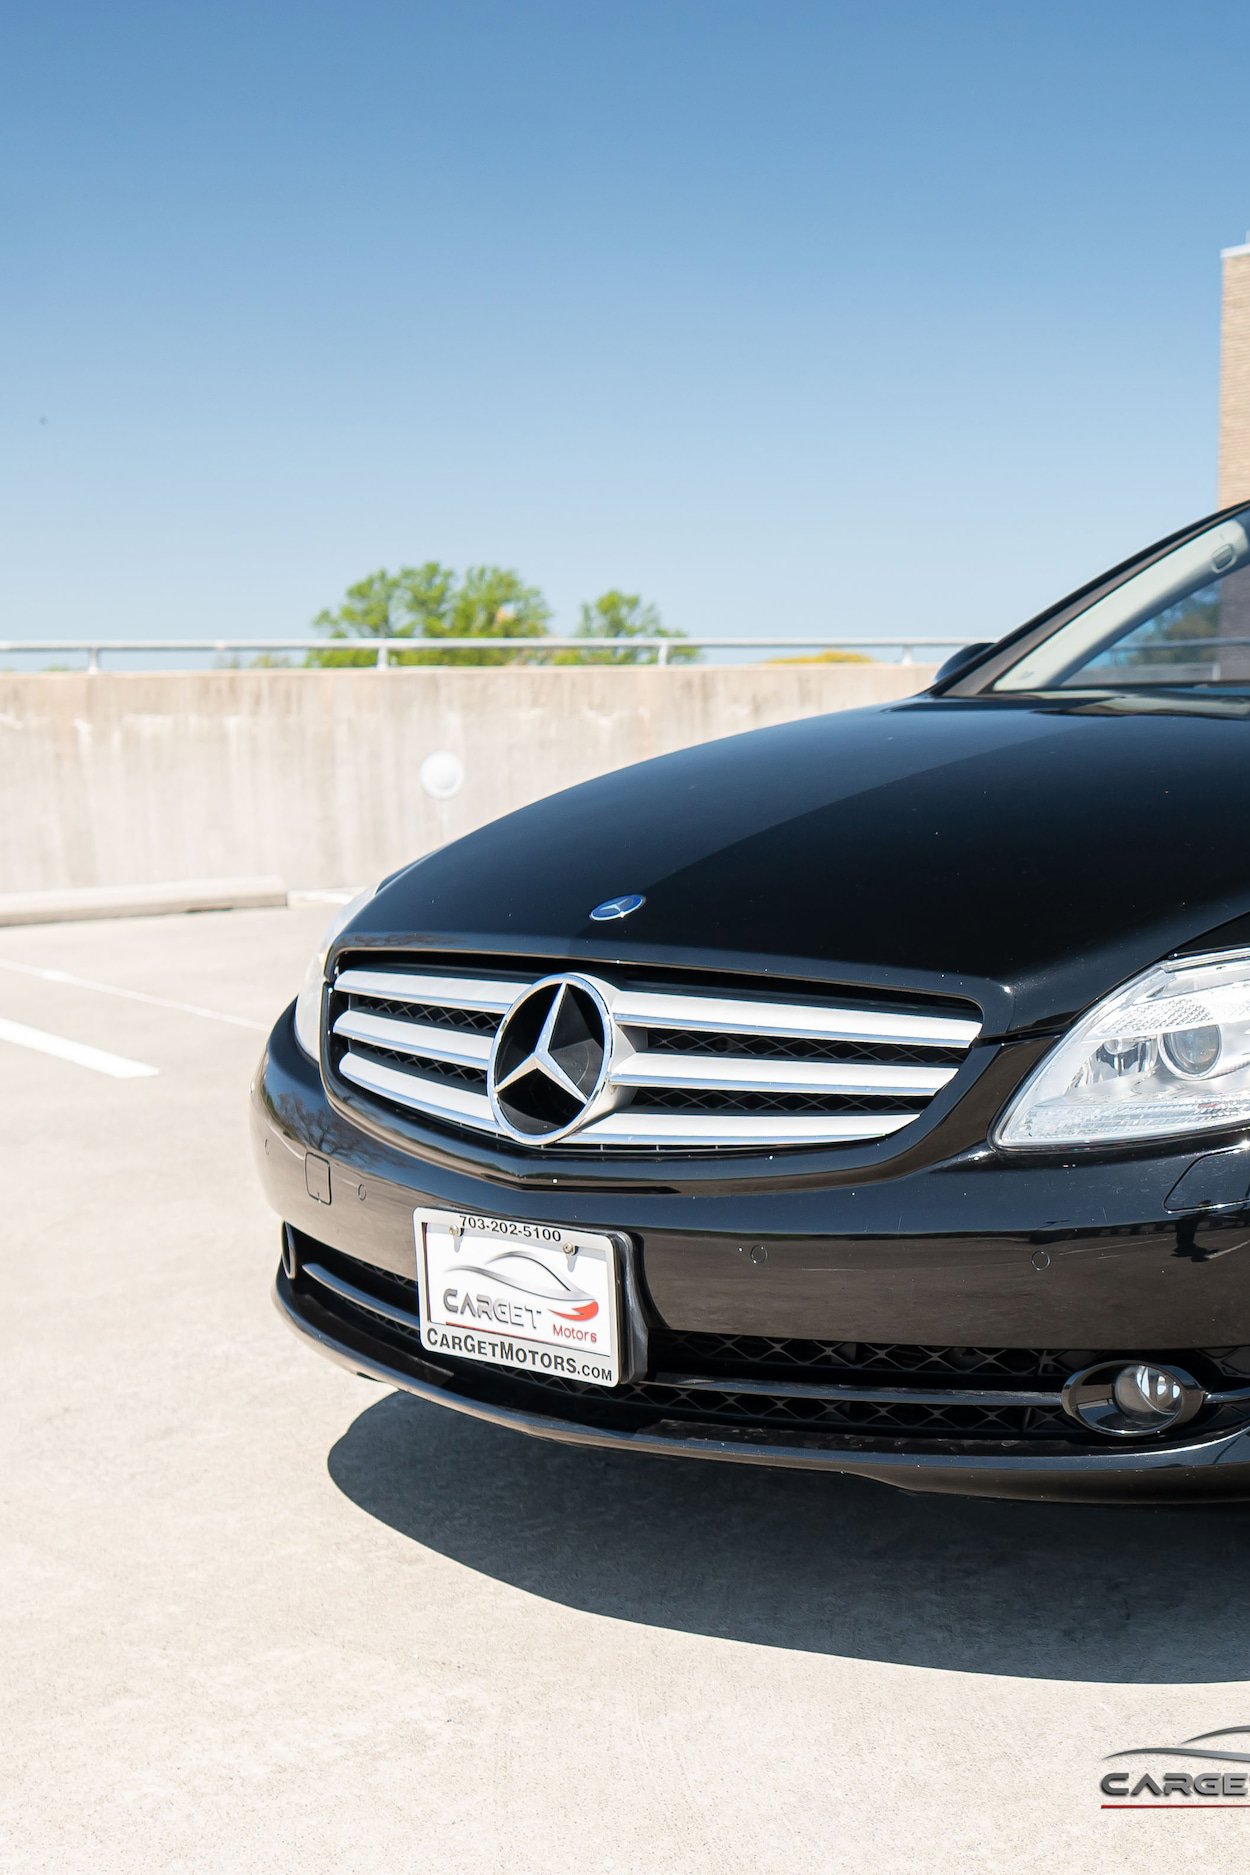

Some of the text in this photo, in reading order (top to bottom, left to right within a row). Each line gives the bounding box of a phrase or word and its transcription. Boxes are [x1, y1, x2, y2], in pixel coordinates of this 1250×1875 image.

[459, 1215, 561, 1242] 703-202-5100
[443, 1288, 597, 1343] CARGET Motors
